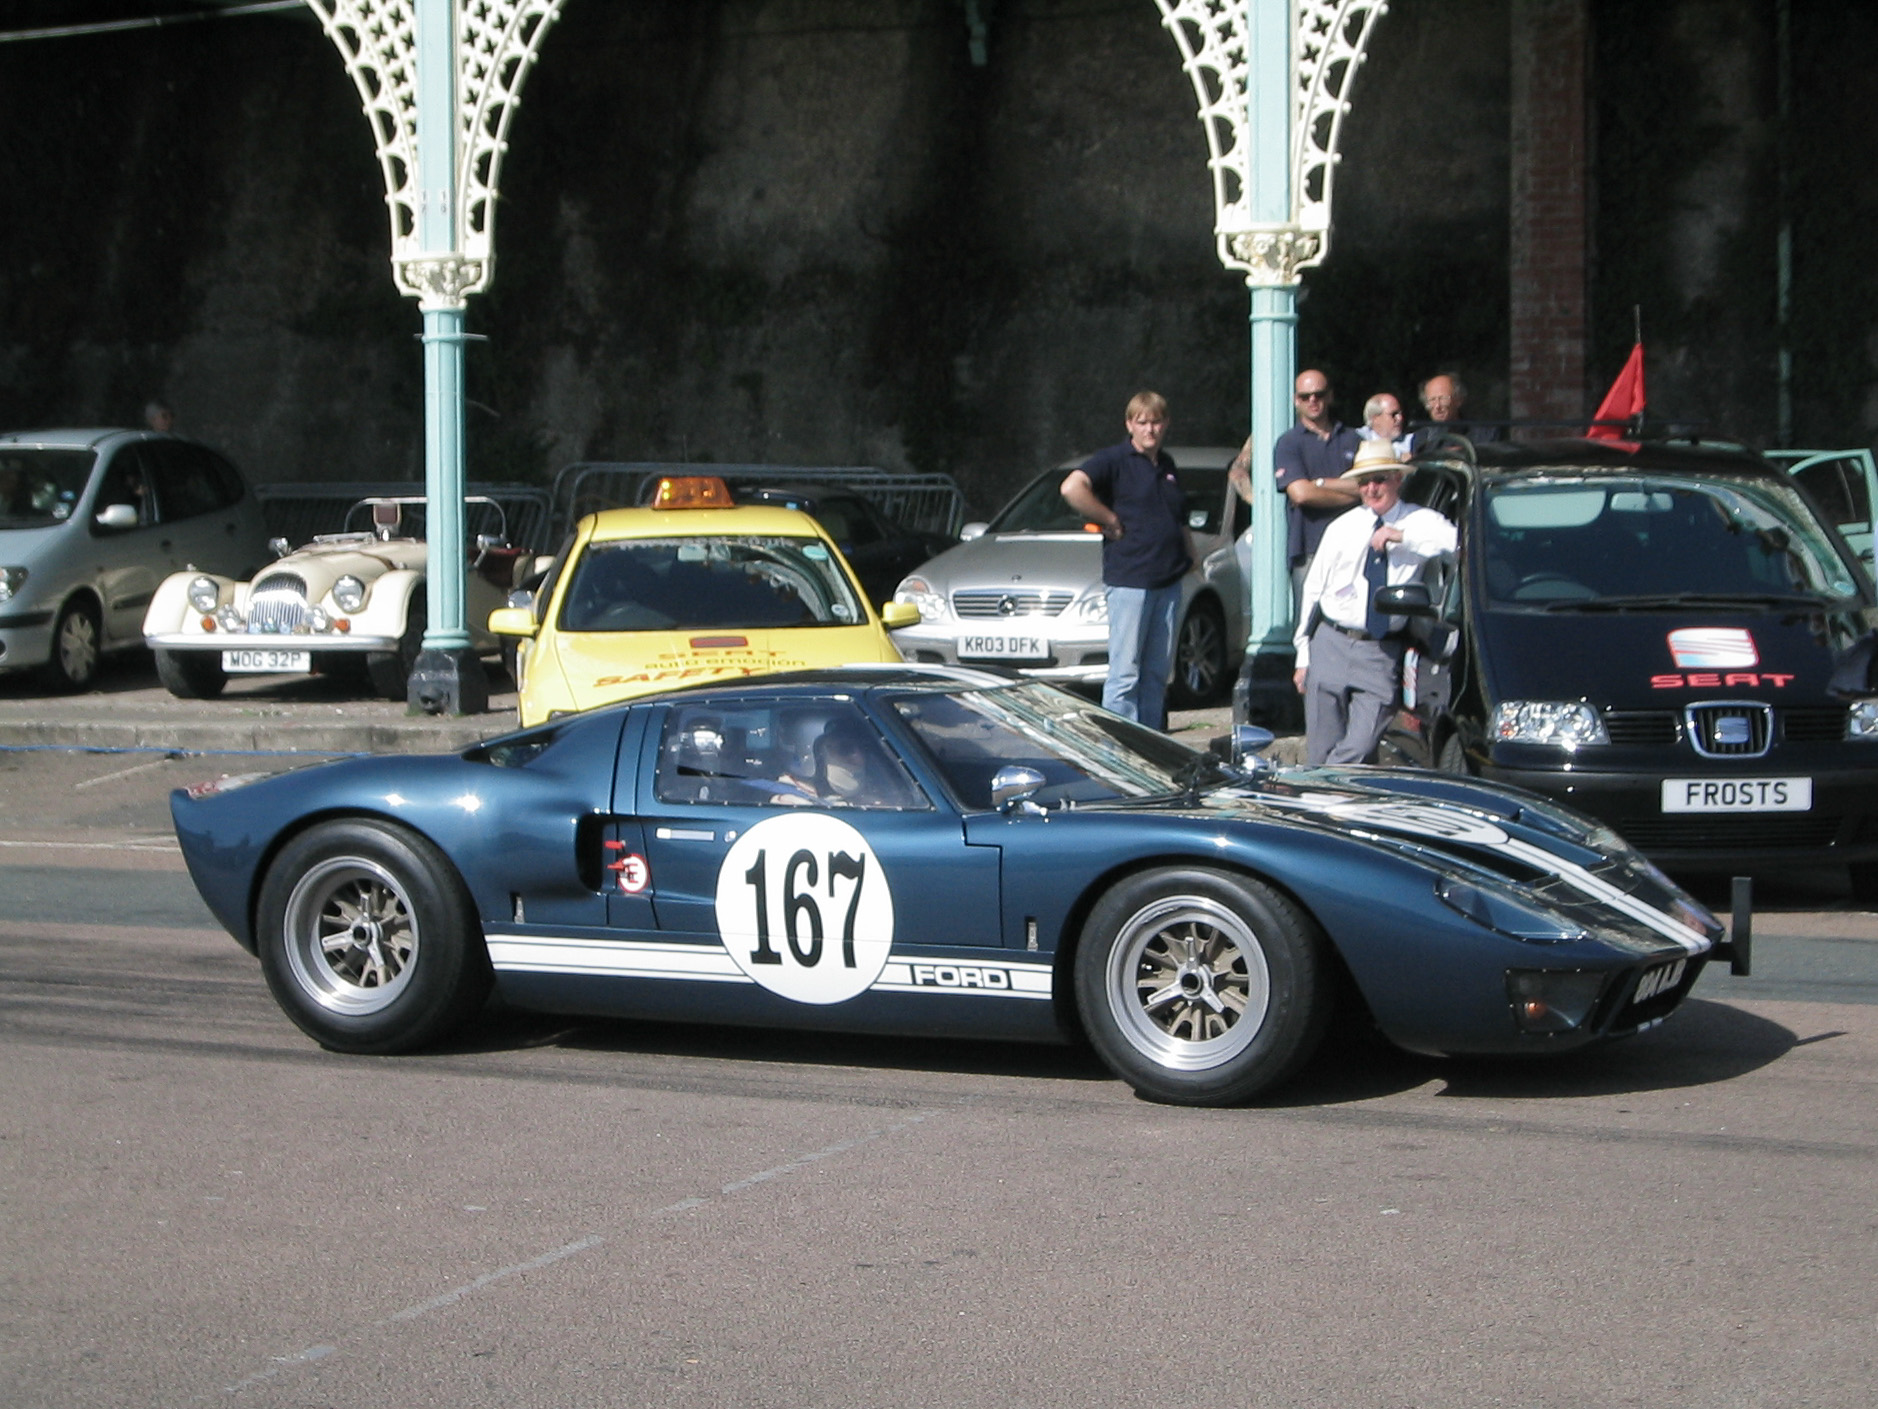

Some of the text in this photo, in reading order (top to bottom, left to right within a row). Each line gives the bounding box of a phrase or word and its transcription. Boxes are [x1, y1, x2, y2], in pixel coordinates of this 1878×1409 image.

[964, 636, 1040, 653] KR03 DFK
[229, 651, 301, 667] MOG 32P
[592, 666, 767, 687] SAFETY
[1650, 672, 1795, 689] SEAT
[1685, 781, 1789, 806] FROSTS
[745, 848, 866, 969] 167
[912, 964, 1009, 989] FORD
